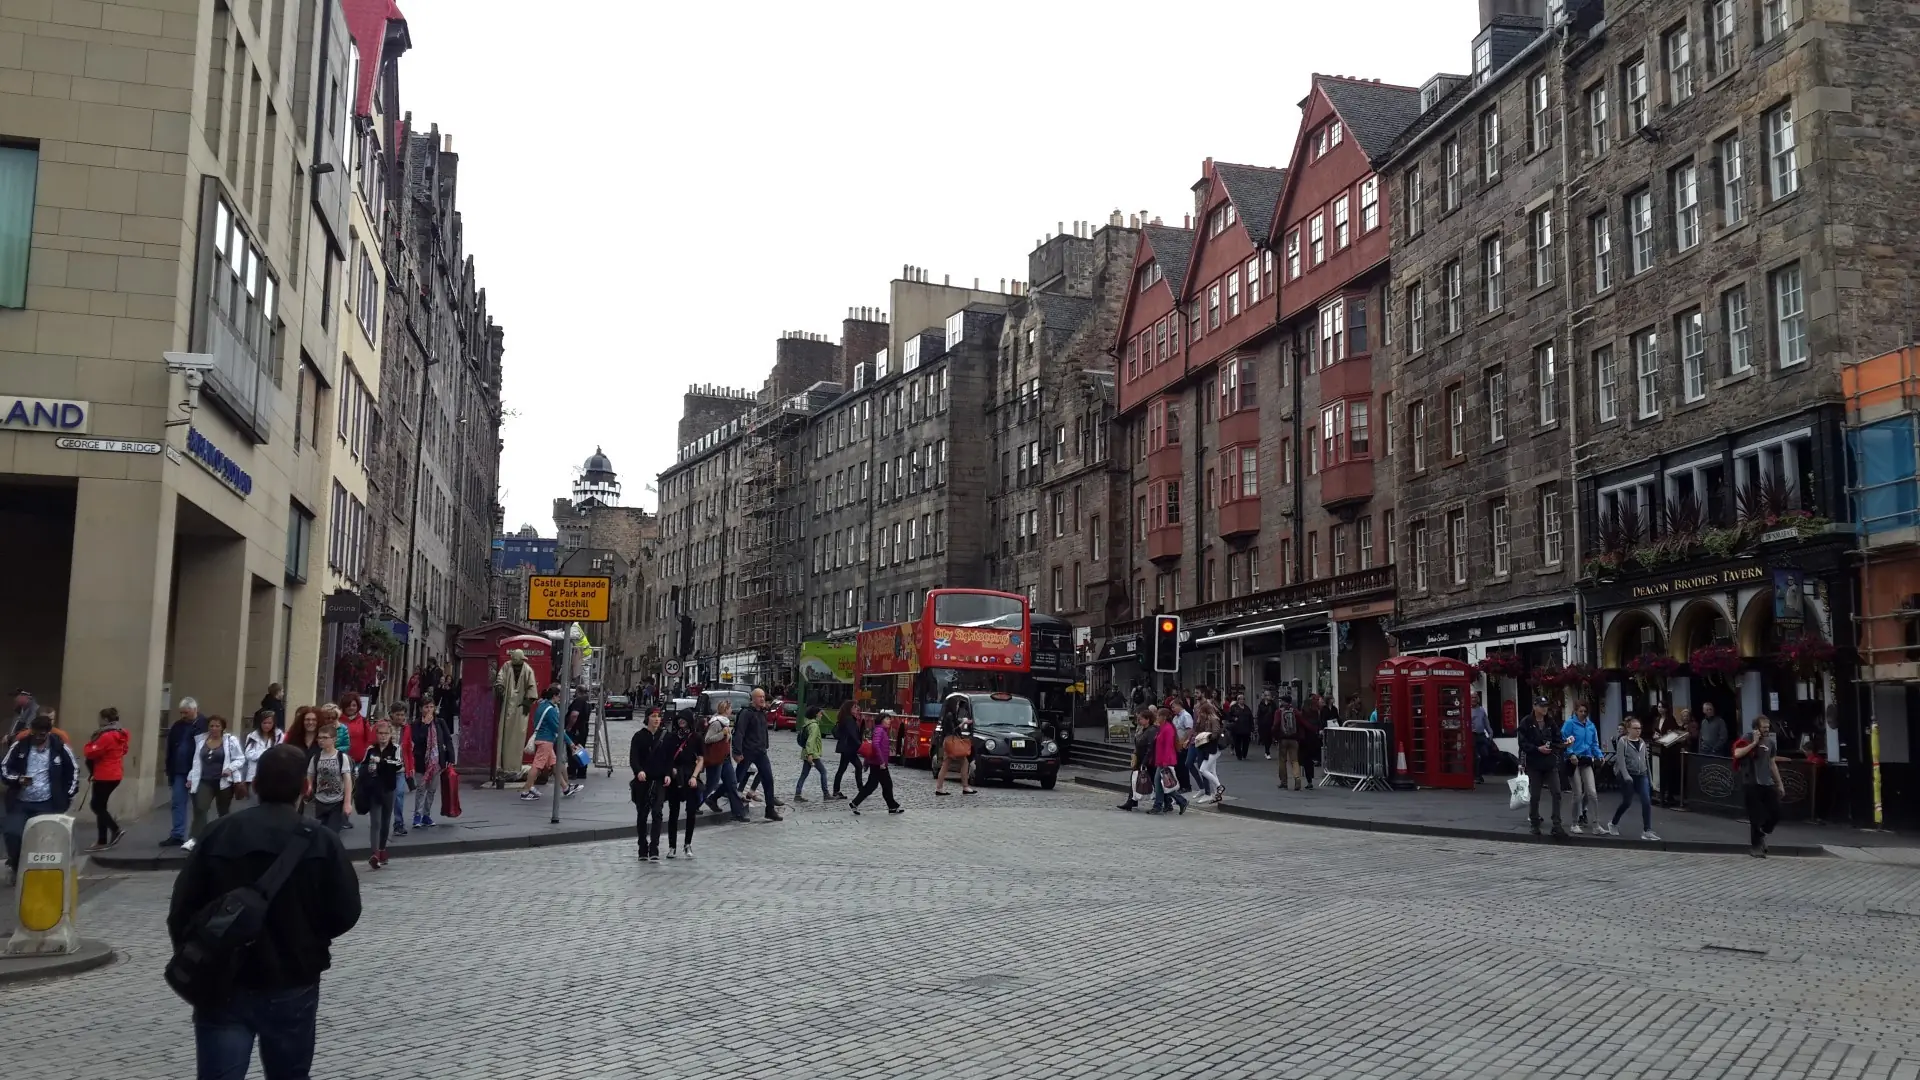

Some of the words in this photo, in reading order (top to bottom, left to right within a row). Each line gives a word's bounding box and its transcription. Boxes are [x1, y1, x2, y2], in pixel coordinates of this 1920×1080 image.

[0, 400, 84, 429] AND
[62, 439, 100, 449] GEORGE
[105, 442, 115, 450] IV
[121, 442, 156, 453] BRIDGE
[533, 578, 561, 587] Castle
[563, 579, 606, 590] Esplanade
[1633, 583, 1669, 597] DEACON
[1674, 574, 1718, 590] BRODIE'S
[1722, 566, 1763, 582] TAVERN
[542, 588, 557, 597] Car
[559, 589, 578, 598] Park
[581, 589, 596, 598] and
[548, 599, 588, 608] Castlehill
[546, 609, 590, 618] CLOSED
[934, 628, 953, 641] City
[955, 628, 1010, 646] Sightseeing
[667, 663, 678, 671] 20
